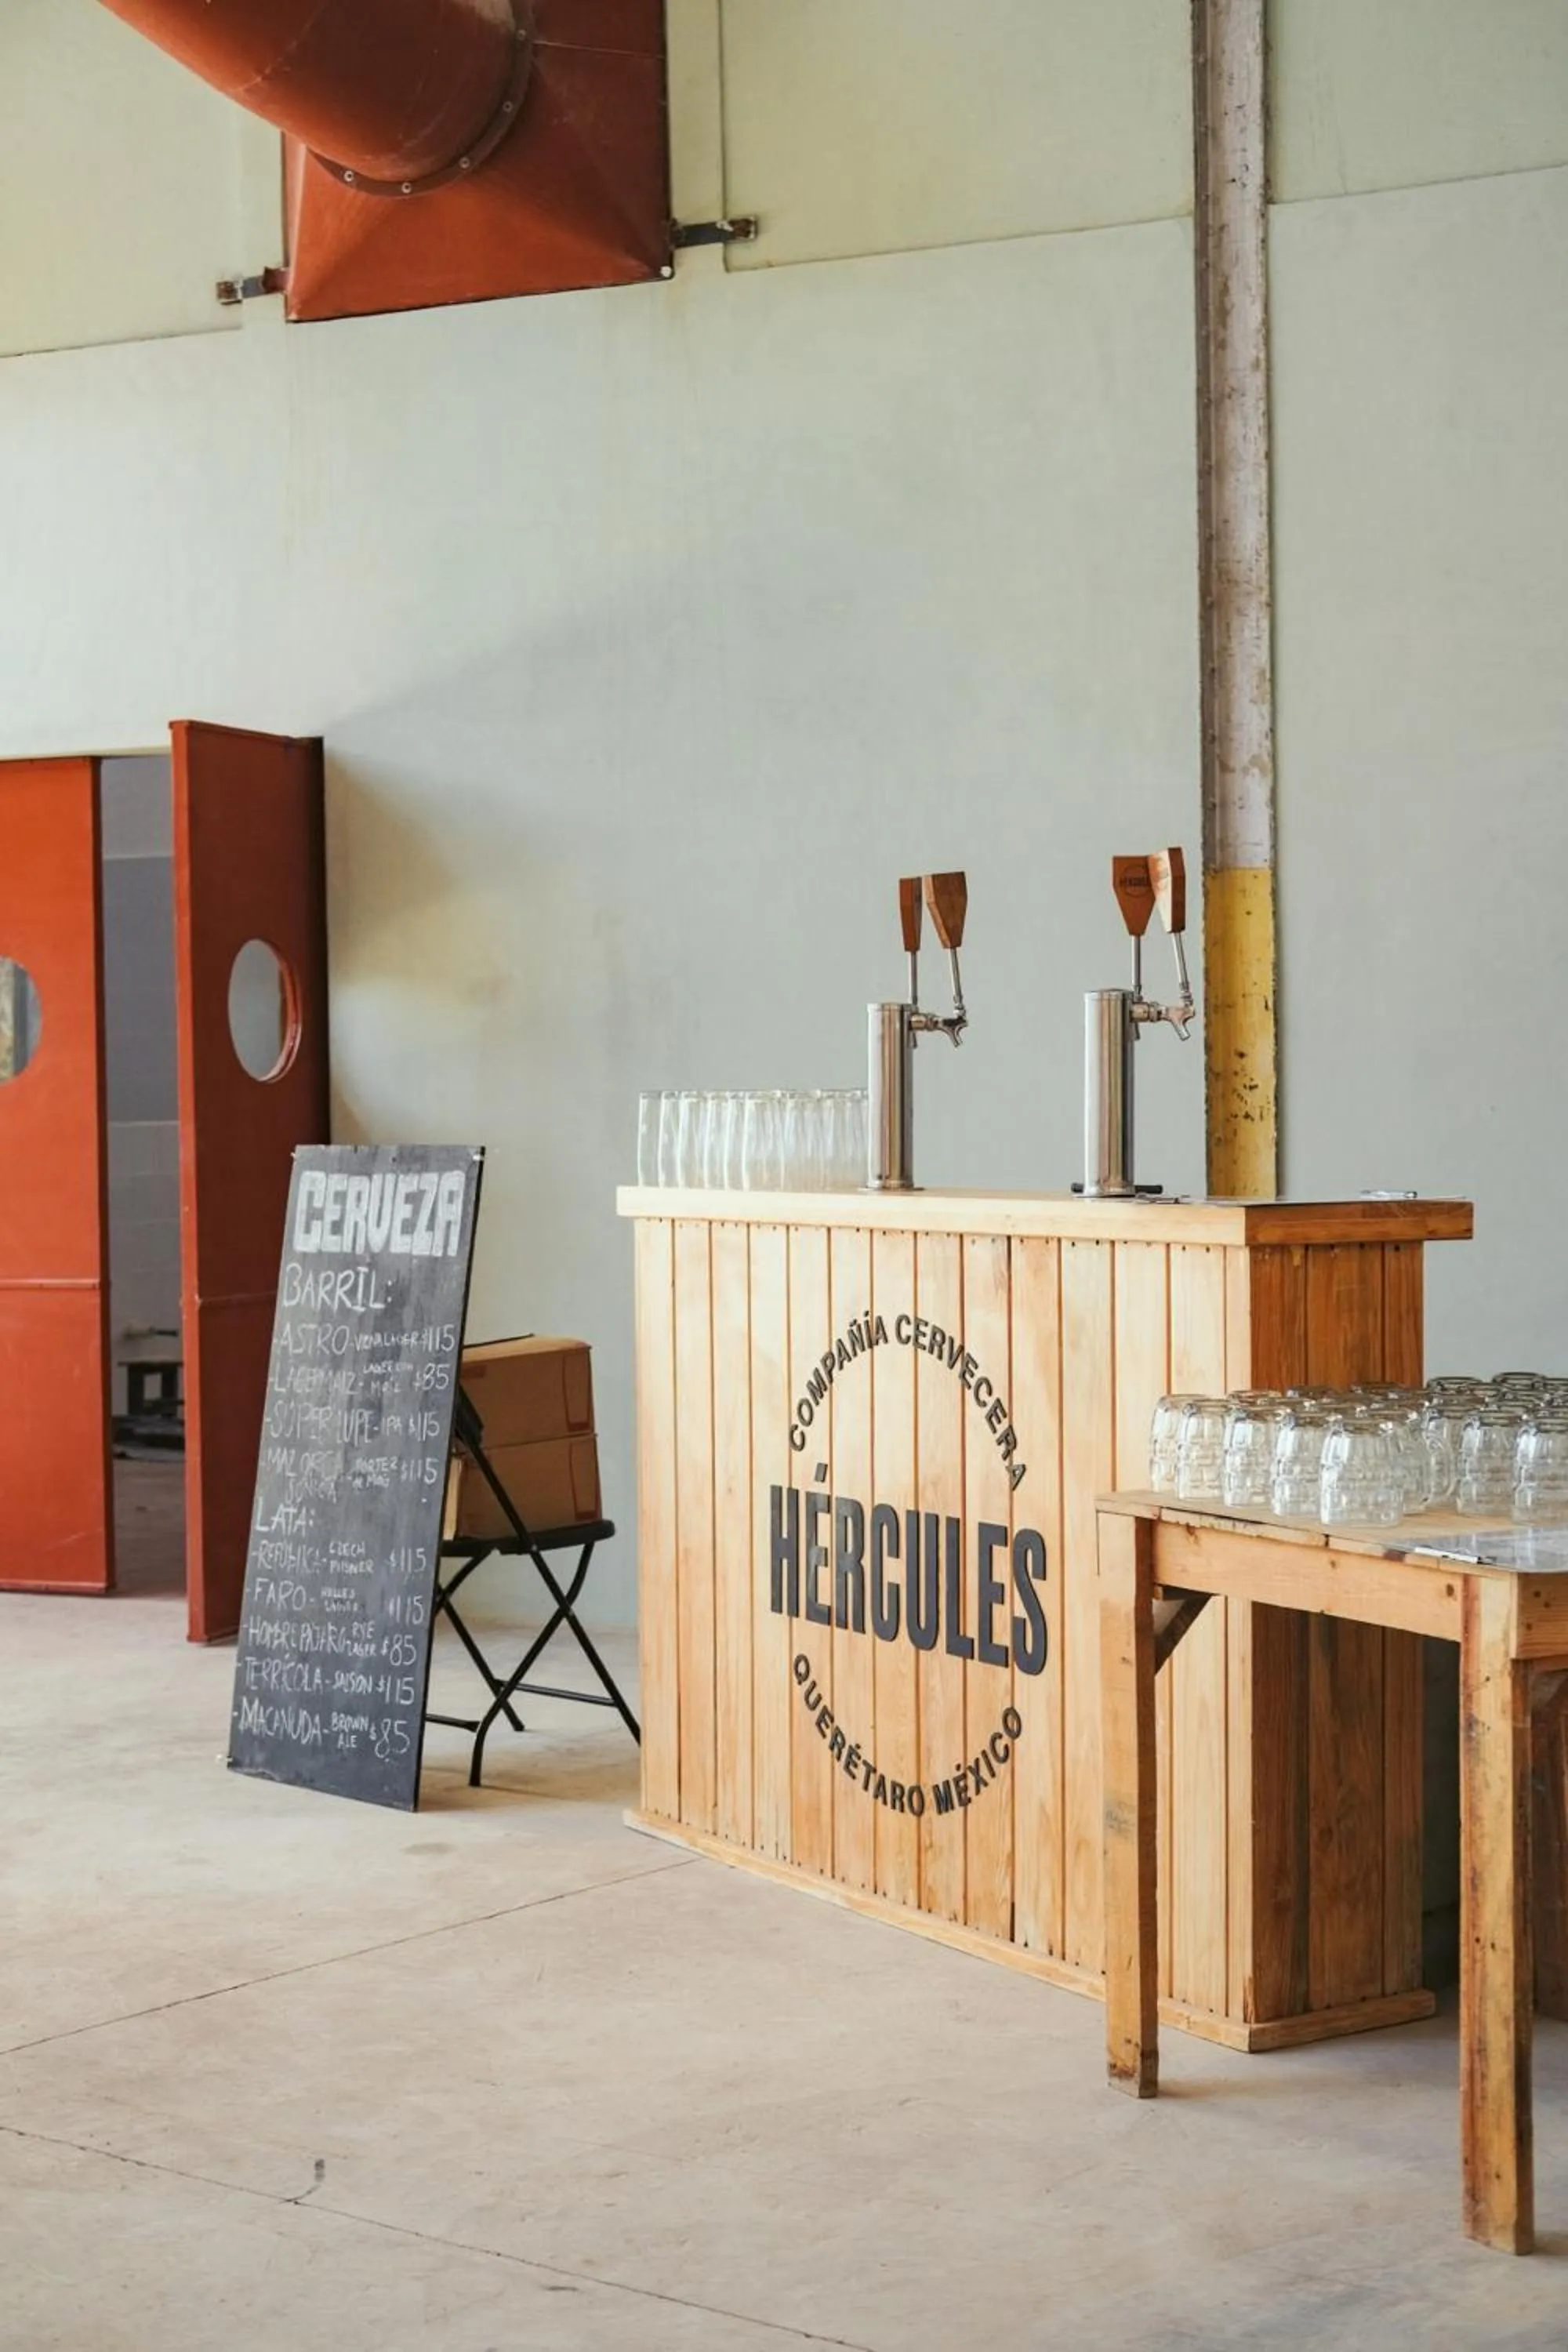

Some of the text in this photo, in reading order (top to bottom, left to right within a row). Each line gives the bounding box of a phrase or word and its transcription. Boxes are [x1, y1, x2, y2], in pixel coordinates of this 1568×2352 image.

[292, 1171, 466, 1257] CERVEZA
[788, 1310, 1026, 1490] COMPAÑÍA CERVECERA
[253, 1577, 307, 1612] FARO
[771, 1462, 1048, 1677] HÉRCULES
[793, 1653, 1022, 1818] QUERÉTARO MÉXICO
